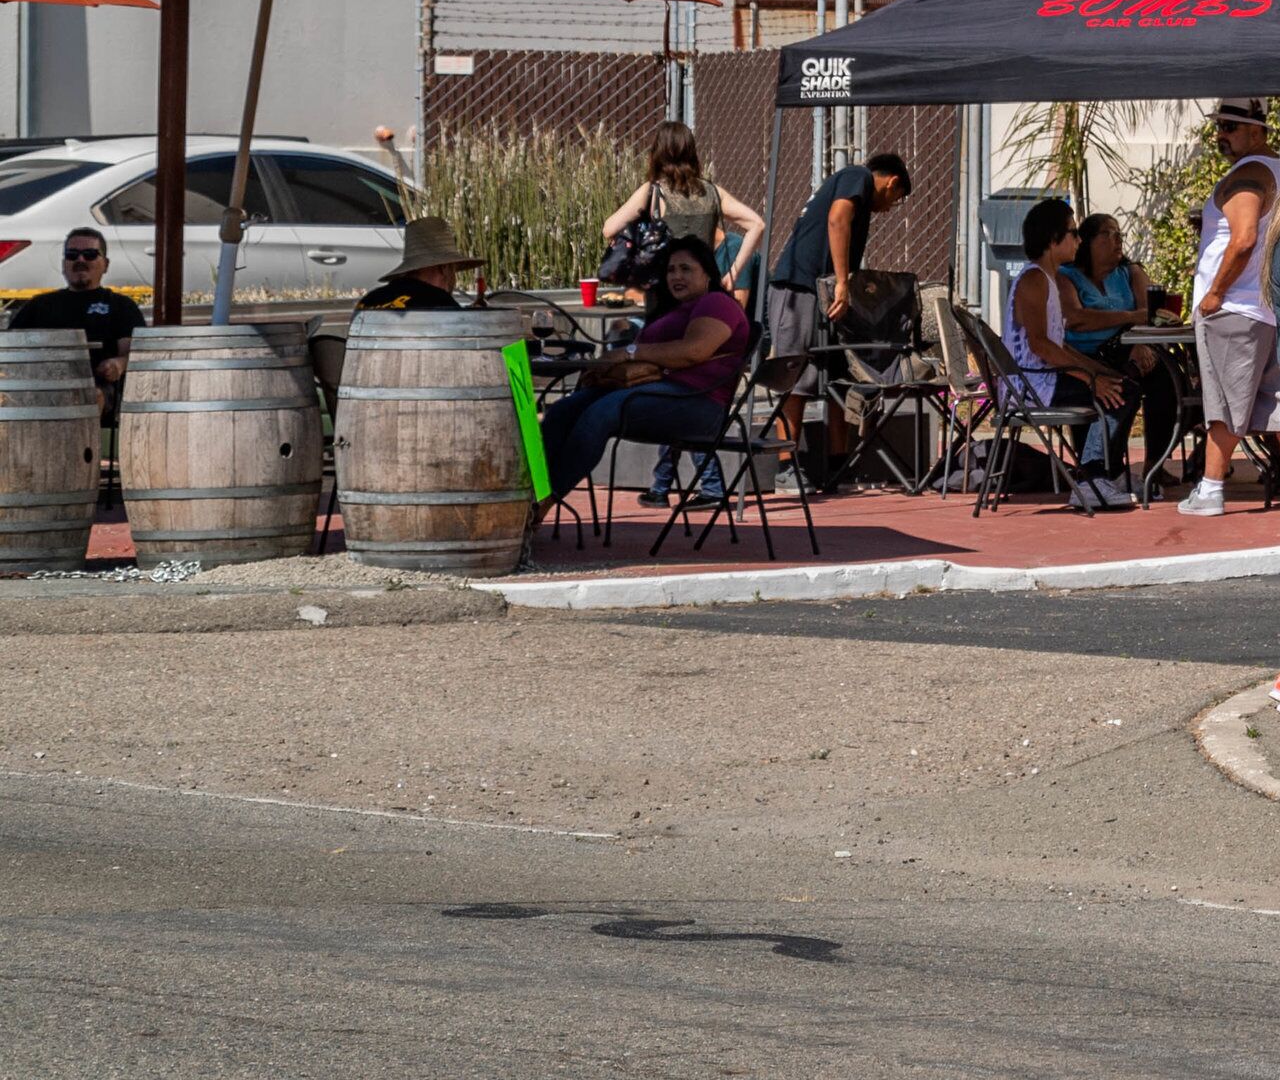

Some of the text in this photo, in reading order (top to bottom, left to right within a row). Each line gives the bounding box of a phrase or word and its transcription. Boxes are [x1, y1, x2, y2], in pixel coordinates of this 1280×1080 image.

[1086, 18, 1198, 28] CAR CLUB
[801, 57, 852, 76] QUIK
[800, 76, 851, 90] SHADE
[800, 90, 851, 99] EXPEDITION
